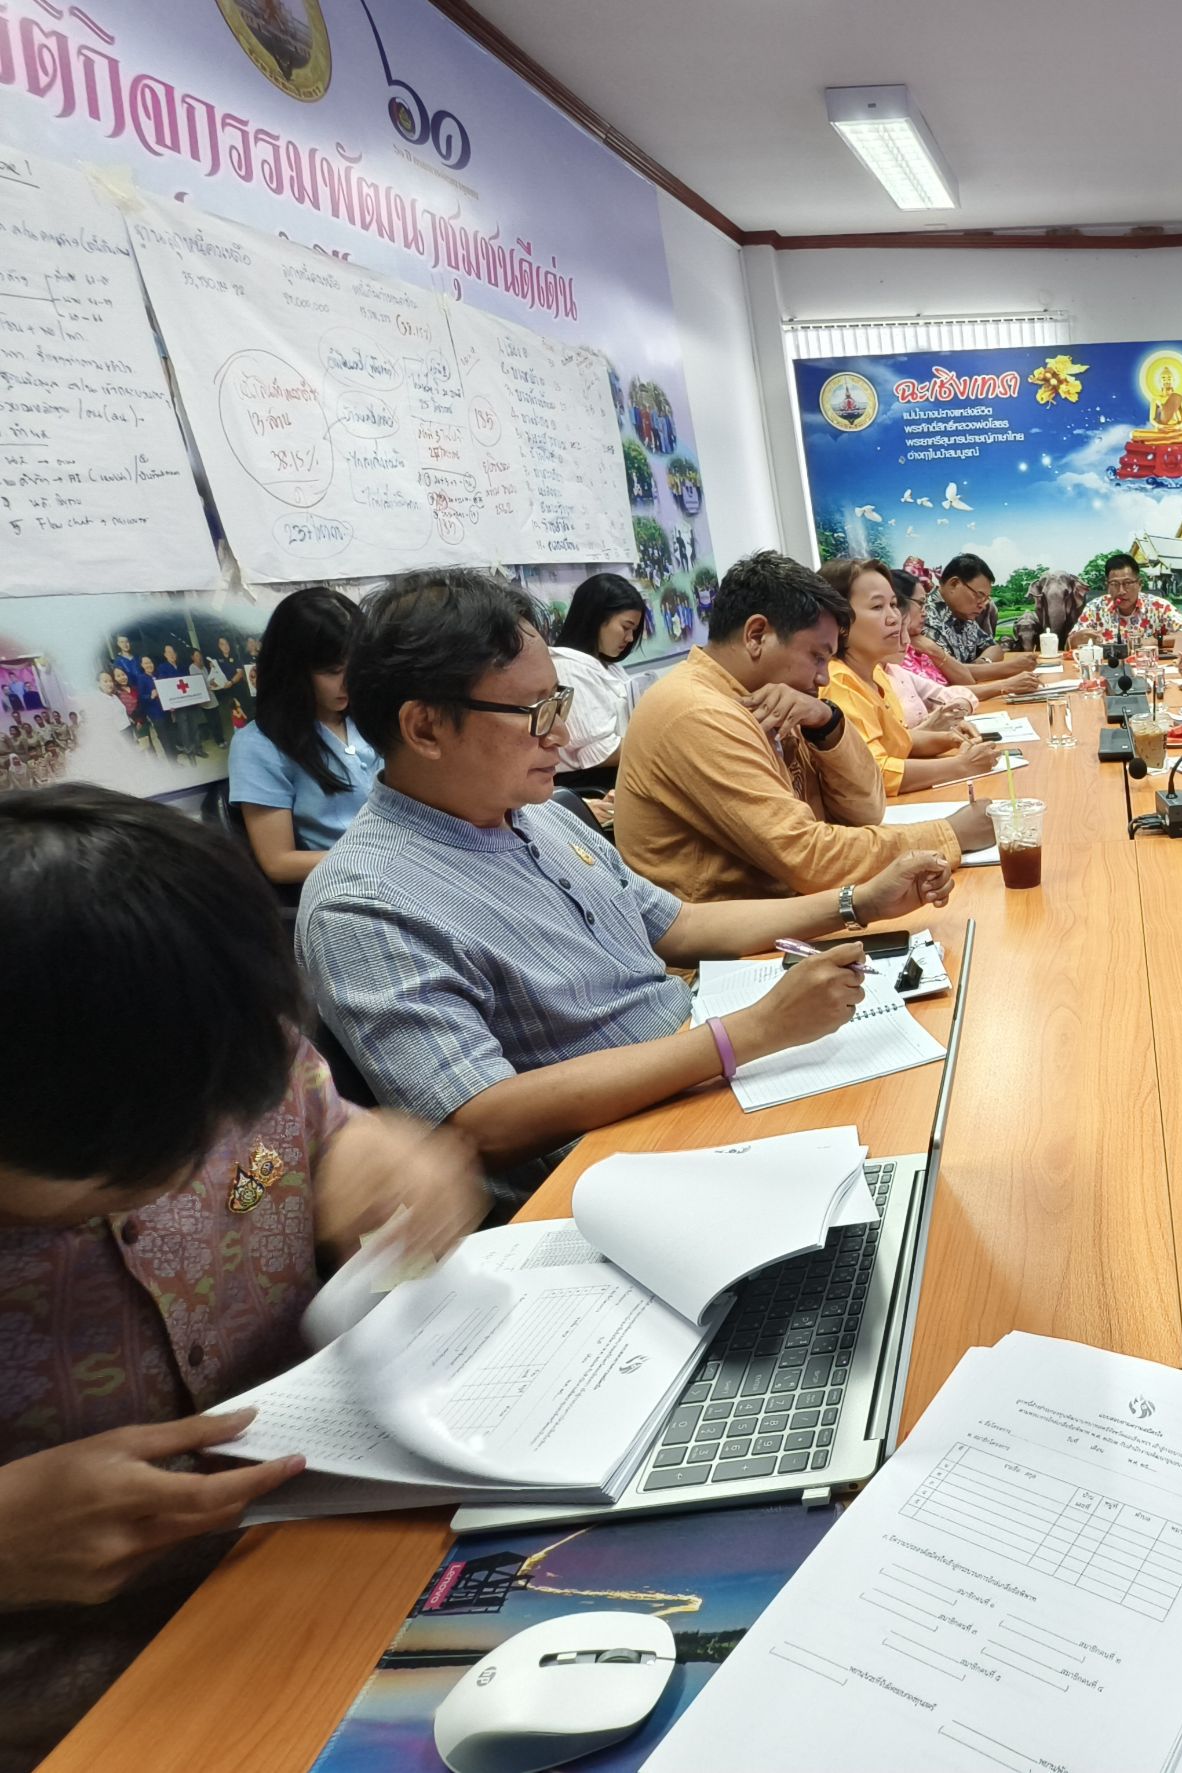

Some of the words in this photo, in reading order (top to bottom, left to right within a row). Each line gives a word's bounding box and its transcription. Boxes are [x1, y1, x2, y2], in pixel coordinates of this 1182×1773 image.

[893, 366, 1020, 403] ฉะเชิงเทรา
[430, 1562, 459, 1605] Lenovo
